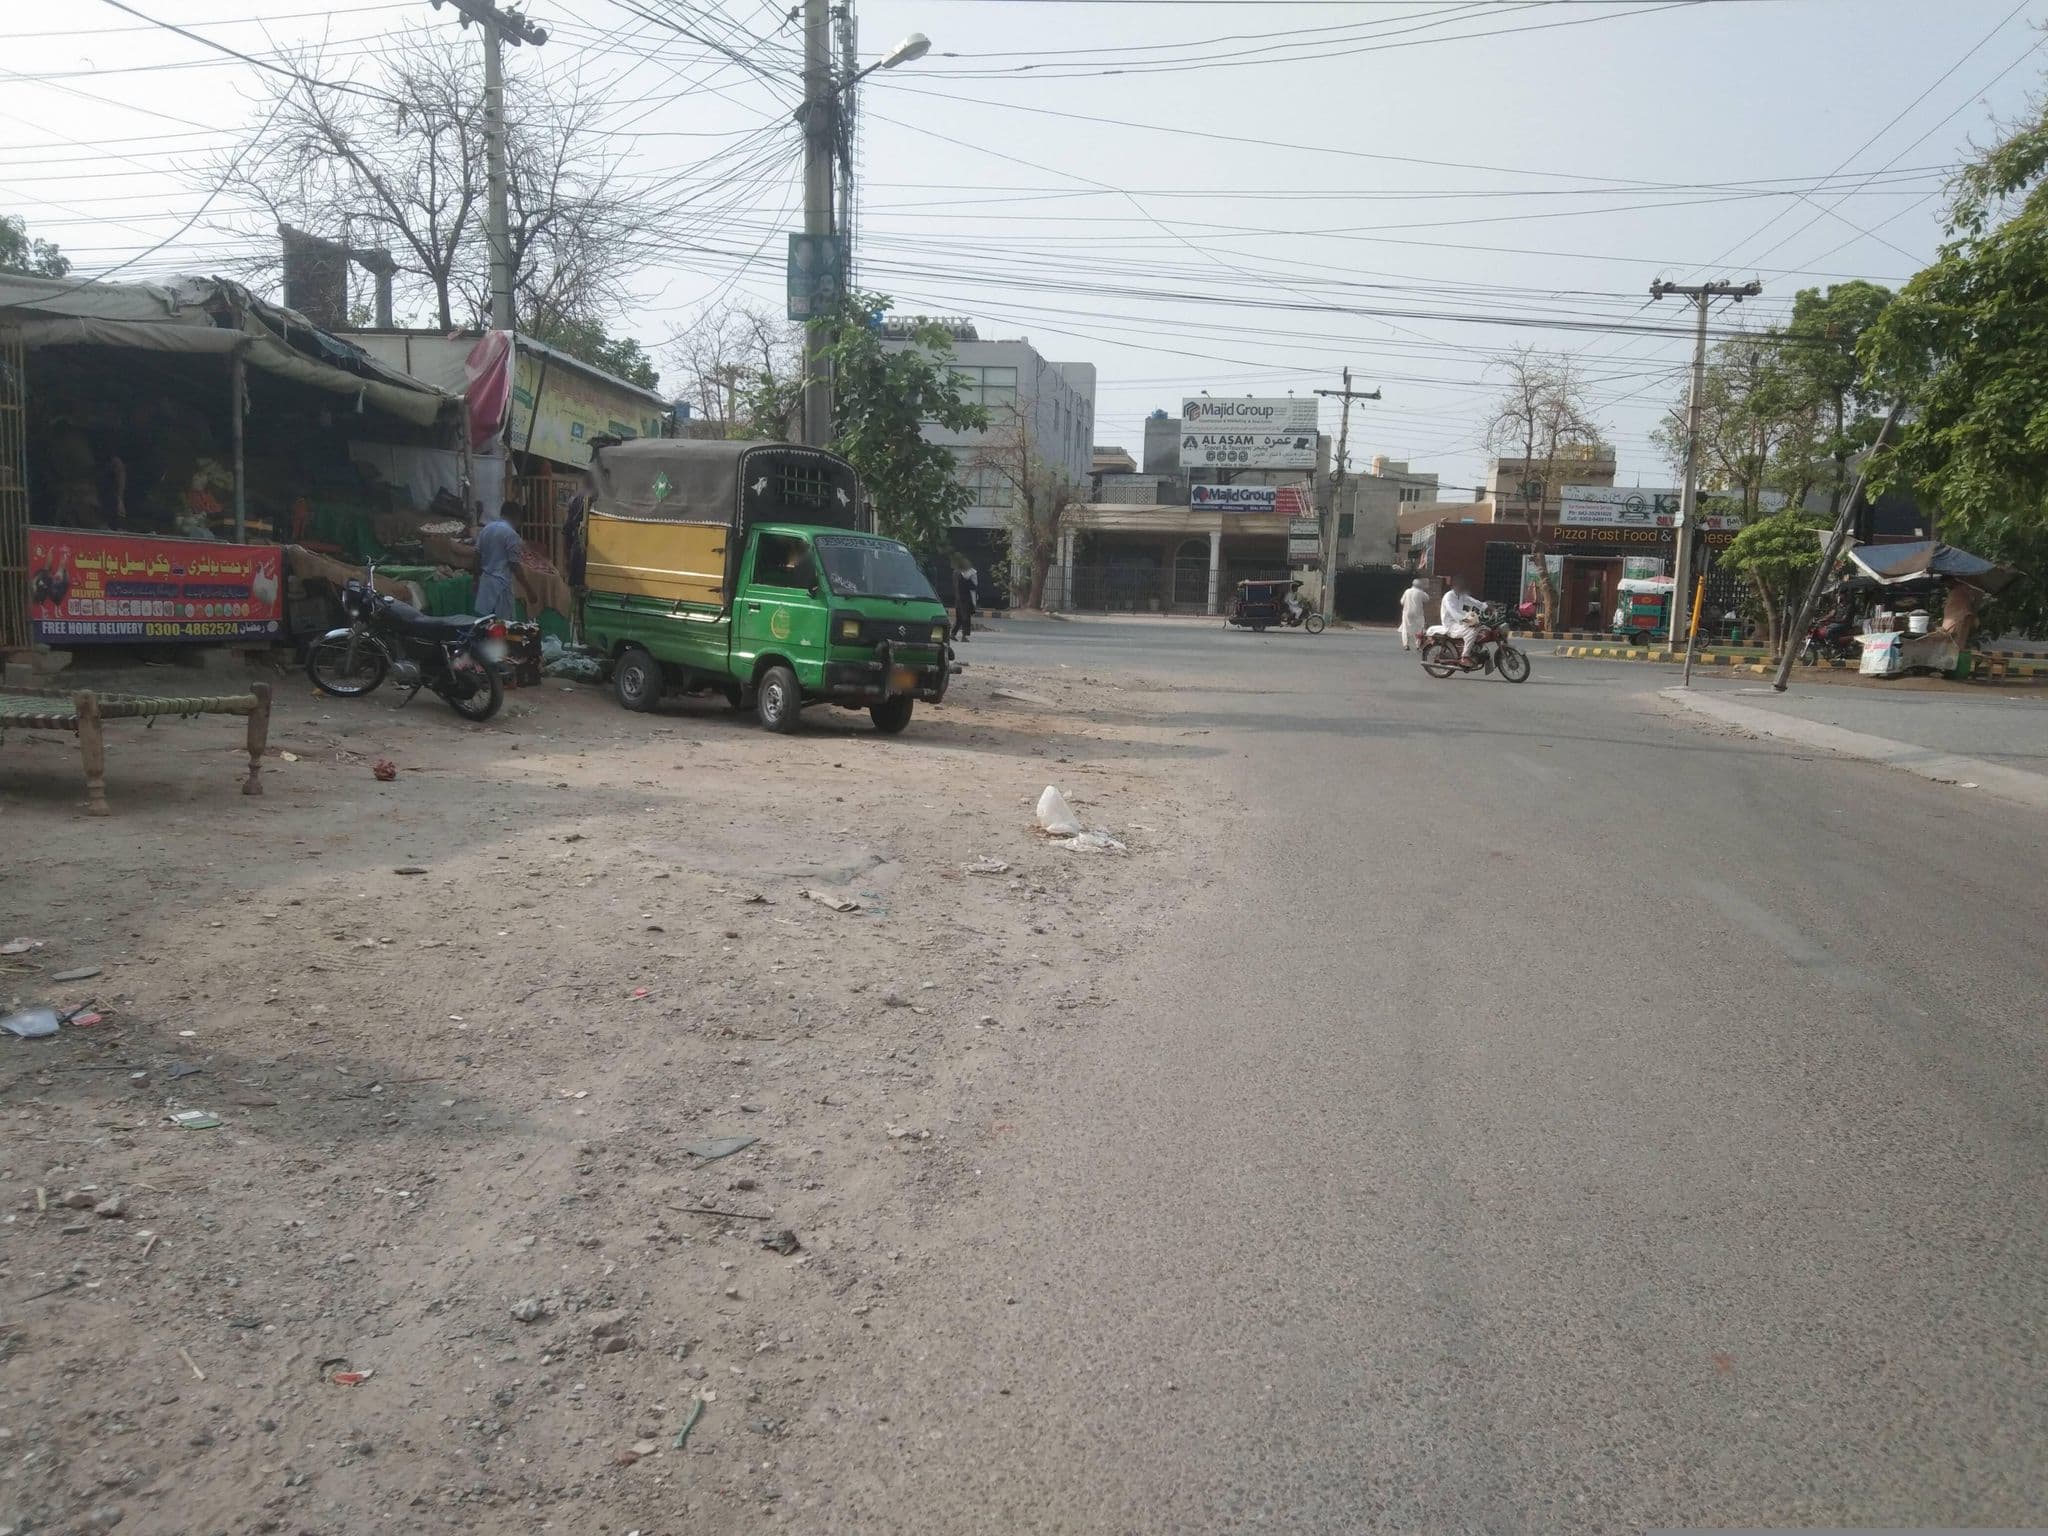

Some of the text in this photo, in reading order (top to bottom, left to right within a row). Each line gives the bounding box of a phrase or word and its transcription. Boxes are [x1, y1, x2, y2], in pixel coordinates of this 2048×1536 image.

[1201, 403, 1234, 418] Majid
[1236, 403, 1274, 419] Group
[1202, 435, 1254, 445] AL ASAM
[1208, 488, 1239, 503] Majid
[1240, 489, 1276, 504] Group
[1553, 527, 1587, 540] Pizza
[1591, 528, 1620, 541] Fast
[1623, 529, 1658, 542] Food
[1660, 529, 1673, 542] &
[42, 622, 67, 634] FREE
[68, 622, 97, 635] HOME
[99, 622, 144, 635] DELIVERY
[146, 622, 238, 637] 0300-4862524
